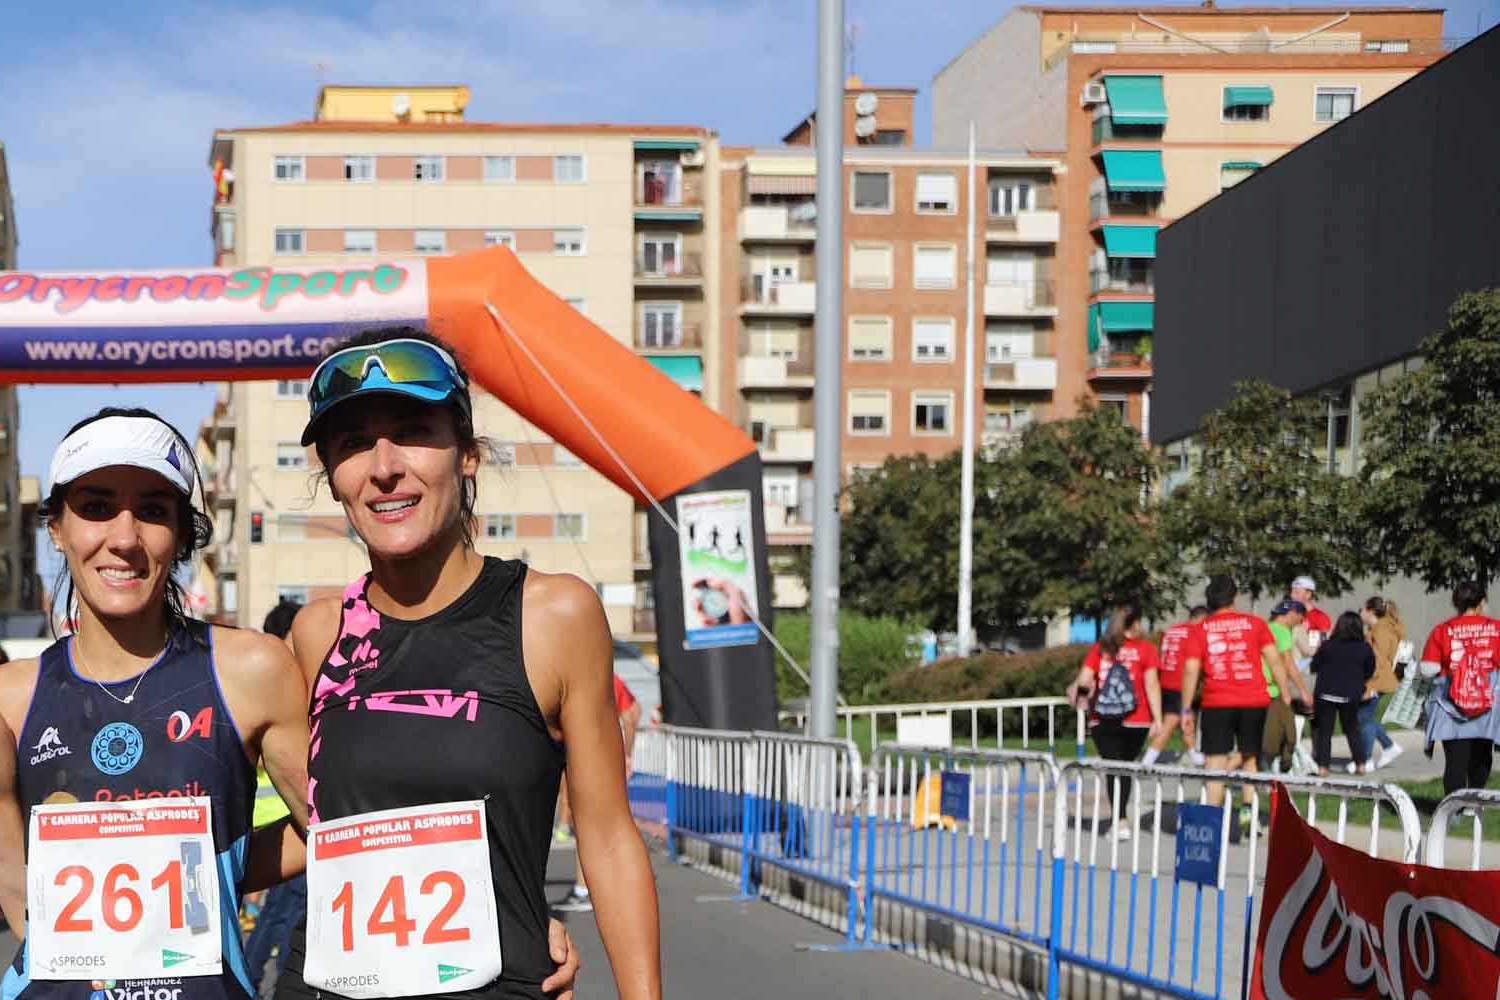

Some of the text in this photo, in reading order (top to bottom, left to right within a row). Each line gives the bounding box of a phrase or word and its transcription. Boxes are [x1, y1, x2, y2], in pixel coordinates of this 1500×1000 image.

[25, 333, 349, 366] www.orycronsport.co
[51, 813, 98, 825] CARRERA
[101, 811, 145, 824] POPULAR
[147, 809, 200, 821] ASPRODES
[325, 827, 360, 844] CARRERA
[363, 820, 411, 837] POPULAR
[414, 814, 474, 830] ASPRODES
[53, 860, 184, 932] 261
[331, 870, 471, 952] 142
[50, 954, 106, 968] ASPRODES
[324, 974, 380, 988] ASPRODES
